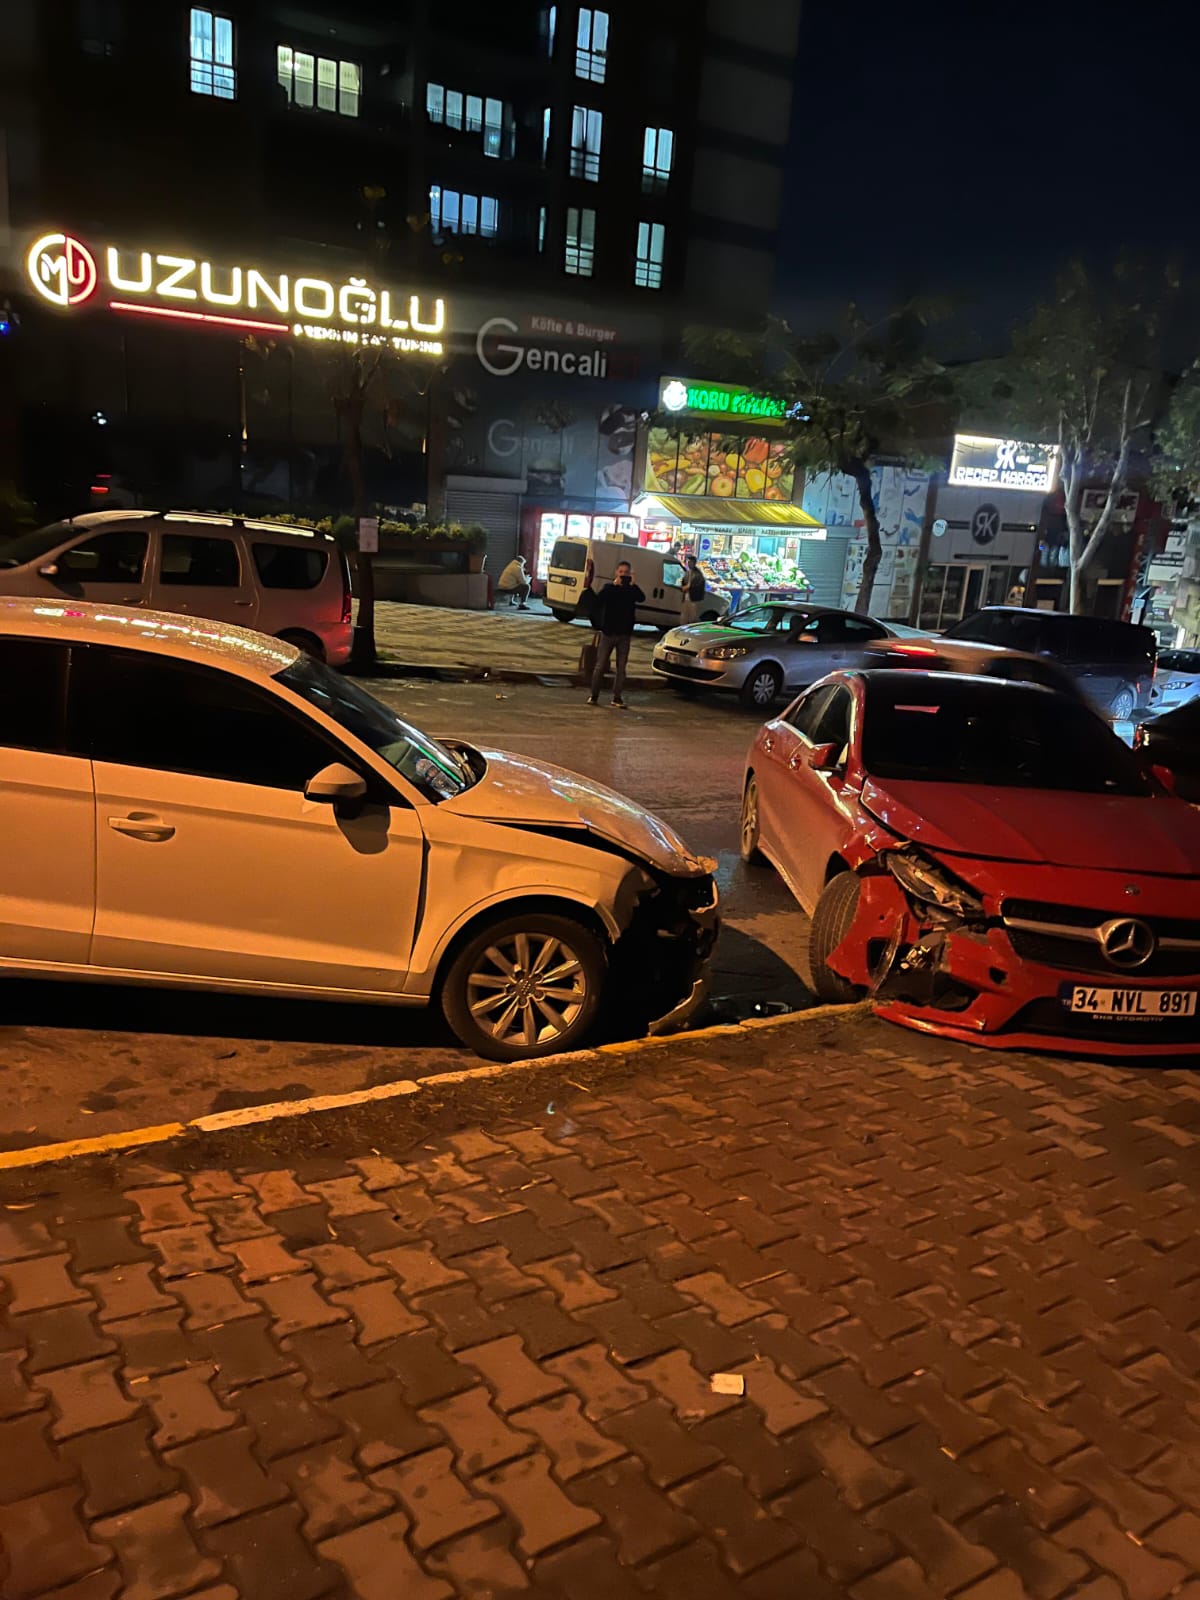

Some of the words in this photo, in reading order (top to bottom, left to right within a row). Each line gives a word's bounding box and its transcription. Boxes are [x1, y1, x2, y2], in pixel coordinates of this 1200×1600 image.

[107, 246, 445, 333] UZUNOĞLU
[532, 316, 563, 334] Köfte
[565, 322, 574, 335] &
[577, 323, 616, 342] Burger
[476, 317, 608, 378] Gencali
[687, 388, 730, 411] KORU
[956, 466, 999, 482] RECEP
[1074, 989, 1098, 1011] 34
[1112, 990, 1147, 1013] NVL
[1159, 992, 1191, 1014] 891
